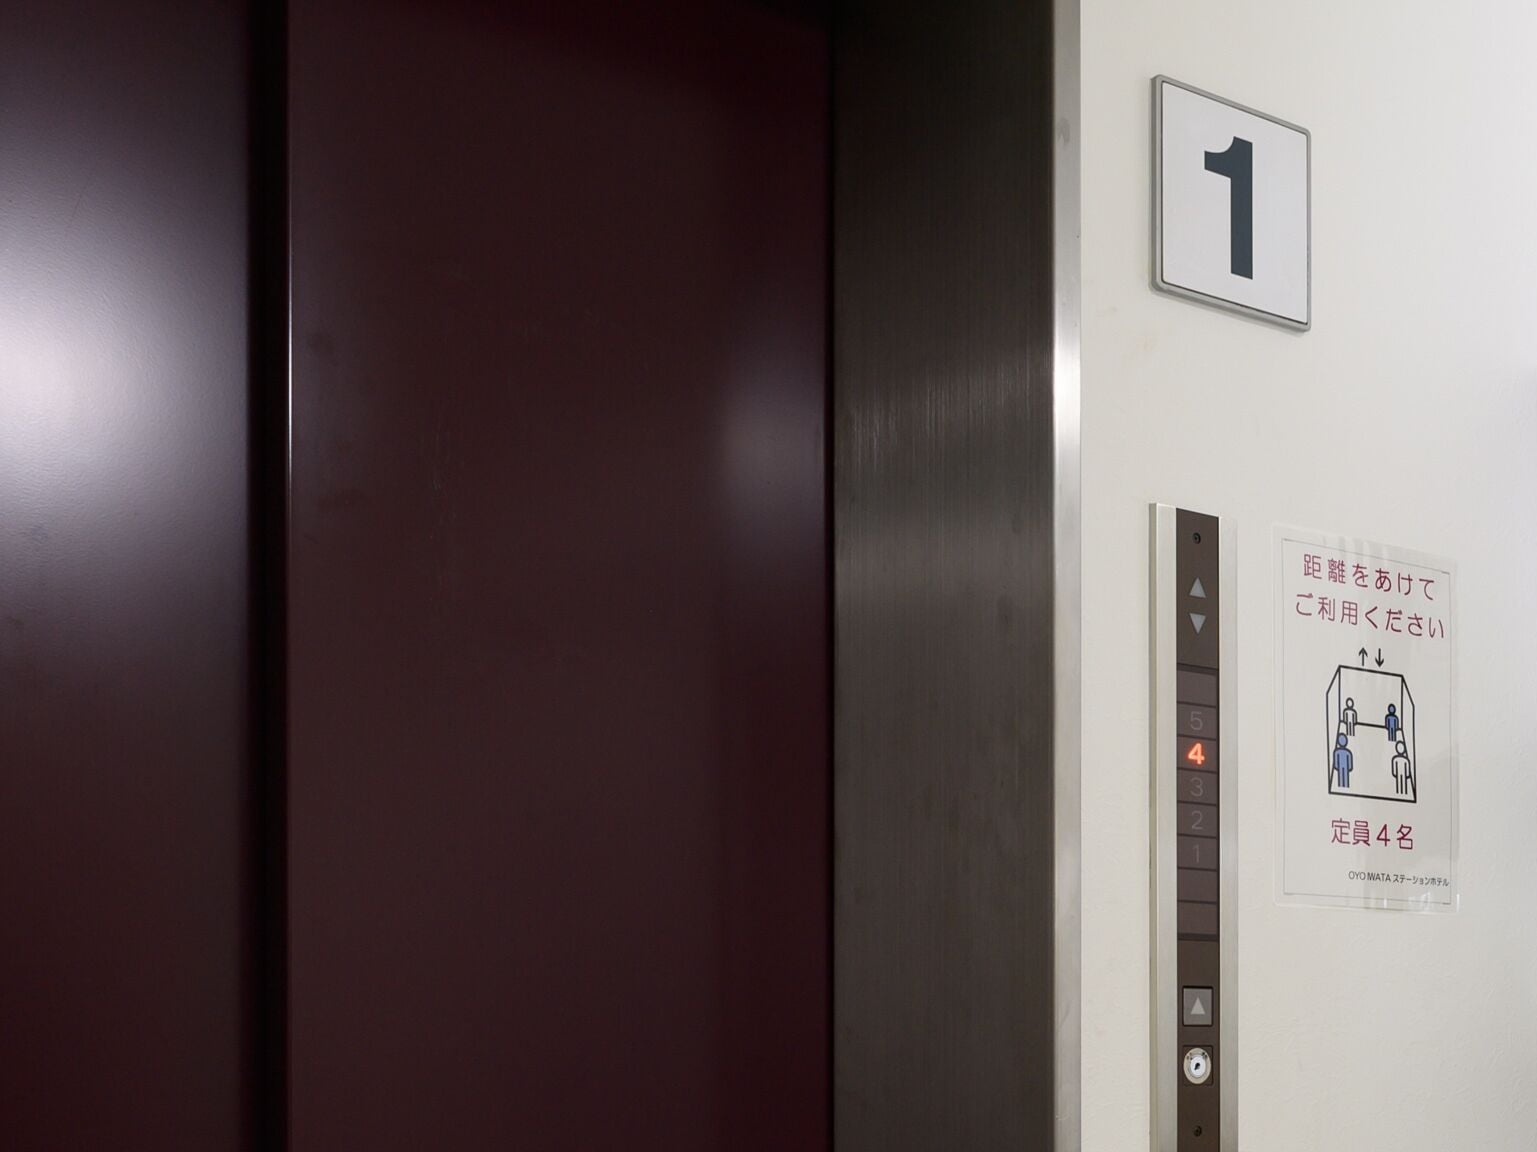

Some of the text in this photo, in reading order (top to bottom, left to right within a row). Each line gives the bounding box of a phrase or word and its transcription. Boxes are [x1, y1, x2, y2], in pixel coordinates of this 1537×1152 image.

[1204, 136, 1253, 280] 1
[1303, 553, 1435, 600] 距離をあけて
[1296, 593, 1444, 638] ご利用ください
[1190, 711, 1204, 732] 5
[1187, 743, 1206, 765] 4
[1190, 776, 1204, 798] 3
[1191, 810, 1204, 831] 2
[1331, 818, 1413, 850] 定員4名
[1348, 870, 1450, 888] OYO IWATA ステーションホテル
